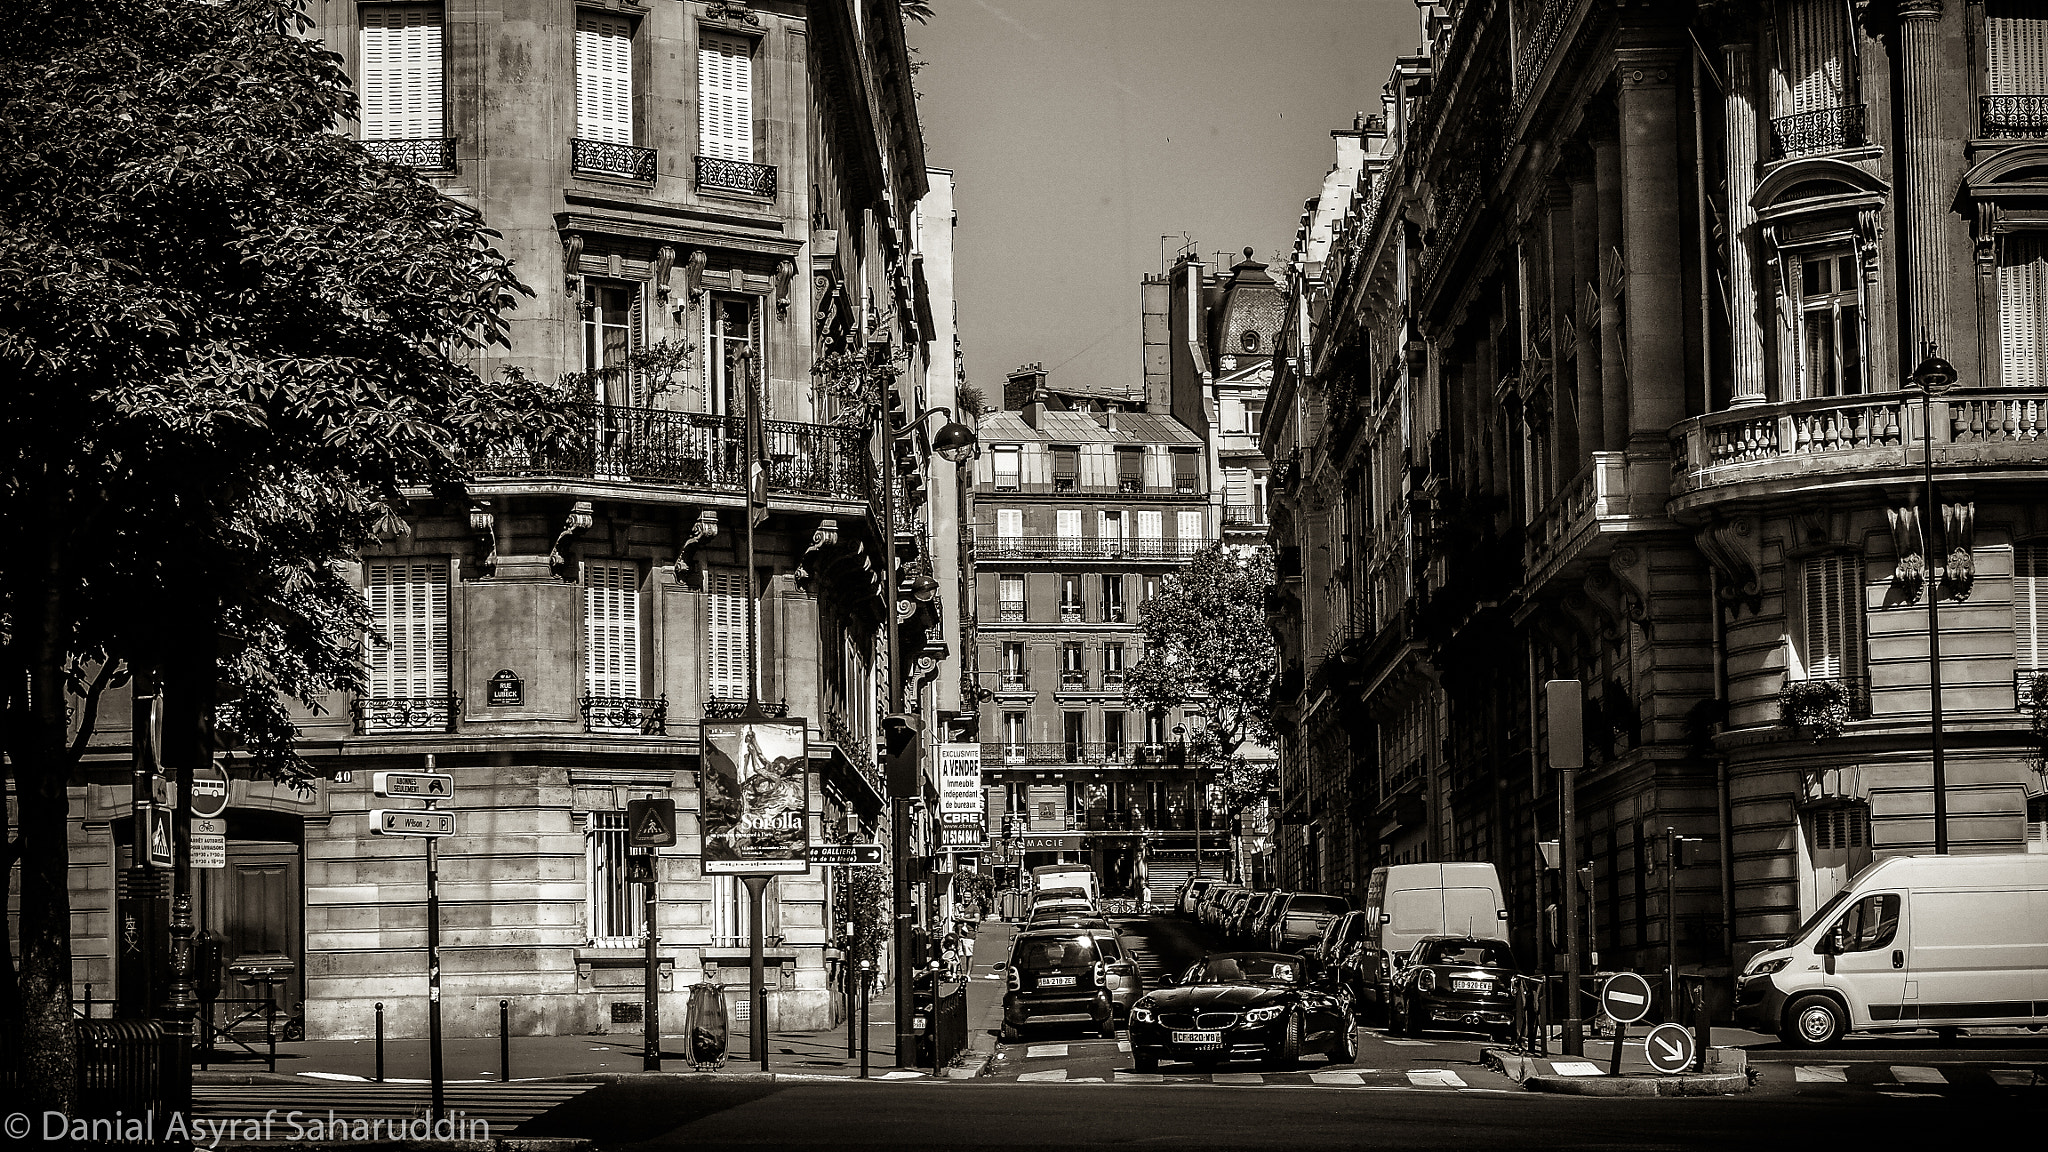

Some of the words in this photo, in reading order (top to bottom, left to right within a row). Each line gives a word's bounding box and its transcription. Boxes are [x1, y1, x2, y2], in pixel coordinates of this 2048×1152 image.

[949, 760, 979, 776] VENDRE
[334, 771, 351, 782] 40
[393, 785, 420, 793] SEULEMENT
[946, 780, 975, 788] Immeuble
[945, 801, 953, 809] de
[953, 801, 976, 809] bureaux
[404, 818, 422, 828] Wilson
[425, 819, 431, 828] 2
[741, 811, 803, 830] Sorolla
[943, 813, 979, 823] CBRE
